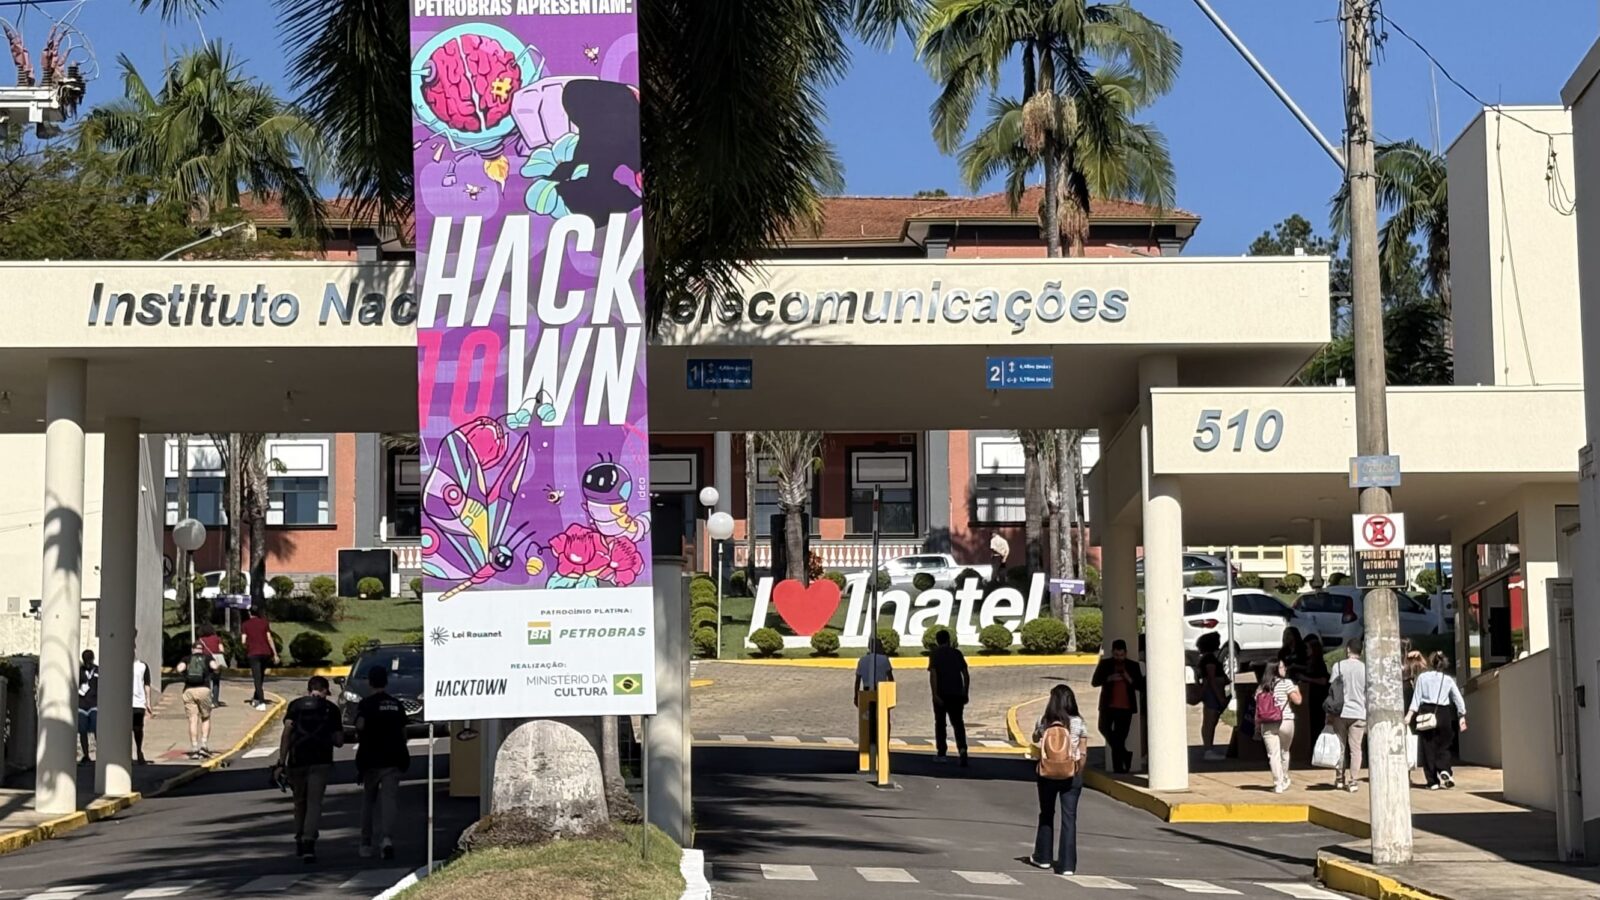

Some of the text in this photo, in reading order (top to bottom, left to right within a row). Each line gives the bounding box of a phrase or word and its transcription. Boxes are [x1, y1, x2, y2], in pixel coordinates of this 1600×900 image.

[414, 0, 633, 17] PETROBRAS APRESENTAM:
[416, 213, 644, 328] HACK
[88, 282, 300, 327] Instituto
[669, 280, 1129, 335] elecomunicações
[990, 366, 1001, 382] 2
[1193, 409, 1284, 453] 510
[1359, 550, 1387, 560] PROIBIDO
[1363, 560, 1398, 570] AUTOMOTIVO
[748, 572, 1046, 637] I Inatel
[540, 607, 633, 616] PATROCÍNIO PLATINA:
[452, 630, 503, 639] Lei Rouanet
[529, 630, 550, 640] BR
[559, 627, 646, 639] PETROBRAS
[510, 661, 568, 670] REALIZAÇÃO:
[526, 673, 608, 686] MINISTÉRIO DA
[434, 678, 508, 697] HACKTOWN
[554, 686, 608, 697] CULTURA
